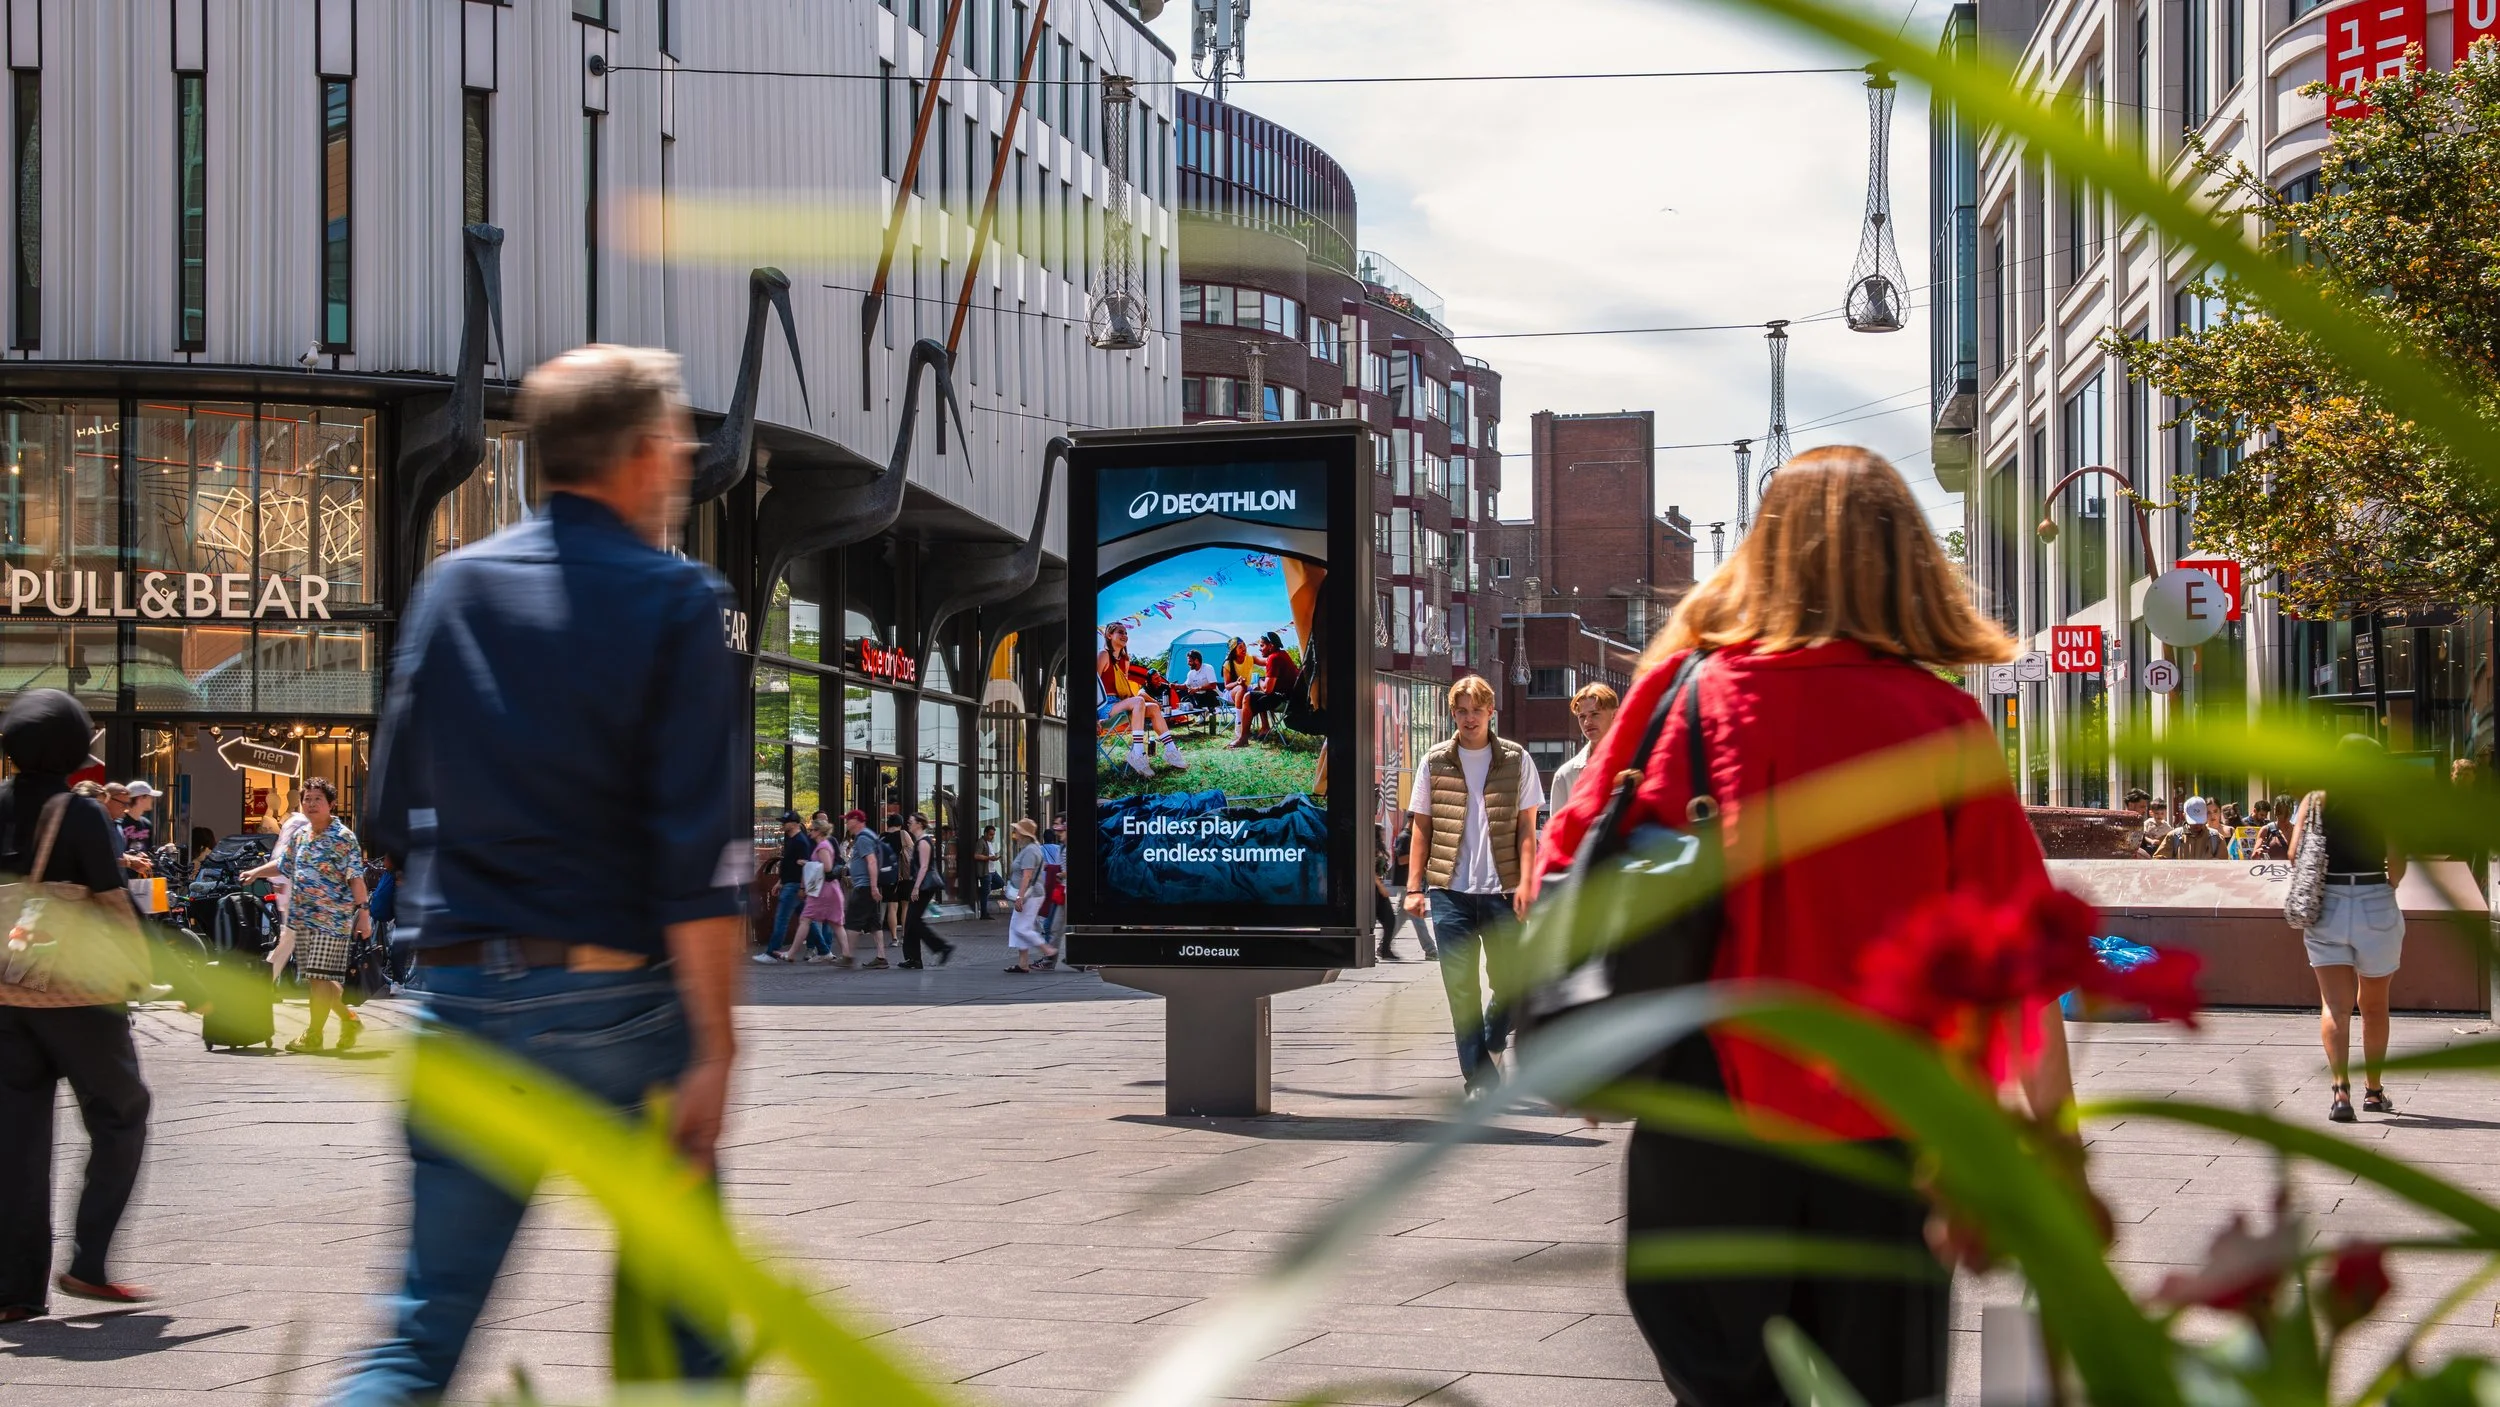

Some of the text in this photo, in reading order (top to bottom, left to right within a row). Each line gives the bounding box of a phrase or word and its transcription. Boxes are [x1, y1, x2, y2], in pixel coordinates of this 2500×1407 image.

[1162, 489, 1296, 515] DECATHLON
[11, 568, 331, 620] PULL&BEAR
[2185, 581, 2207, 620] E
[721, 608, 747, 652] EAR
[2057, 631, 2093, 647] UNI
[2057, 650, 2097, 669] QLO
[253, 749, 284, 764] men
[258, 761, 276, 770] heren
[1123, 816, 1249, 839] Endless play,
[1143, 843, 1306, 862] endless summer
[1178, 945, 1240, 957] JCDecaux
